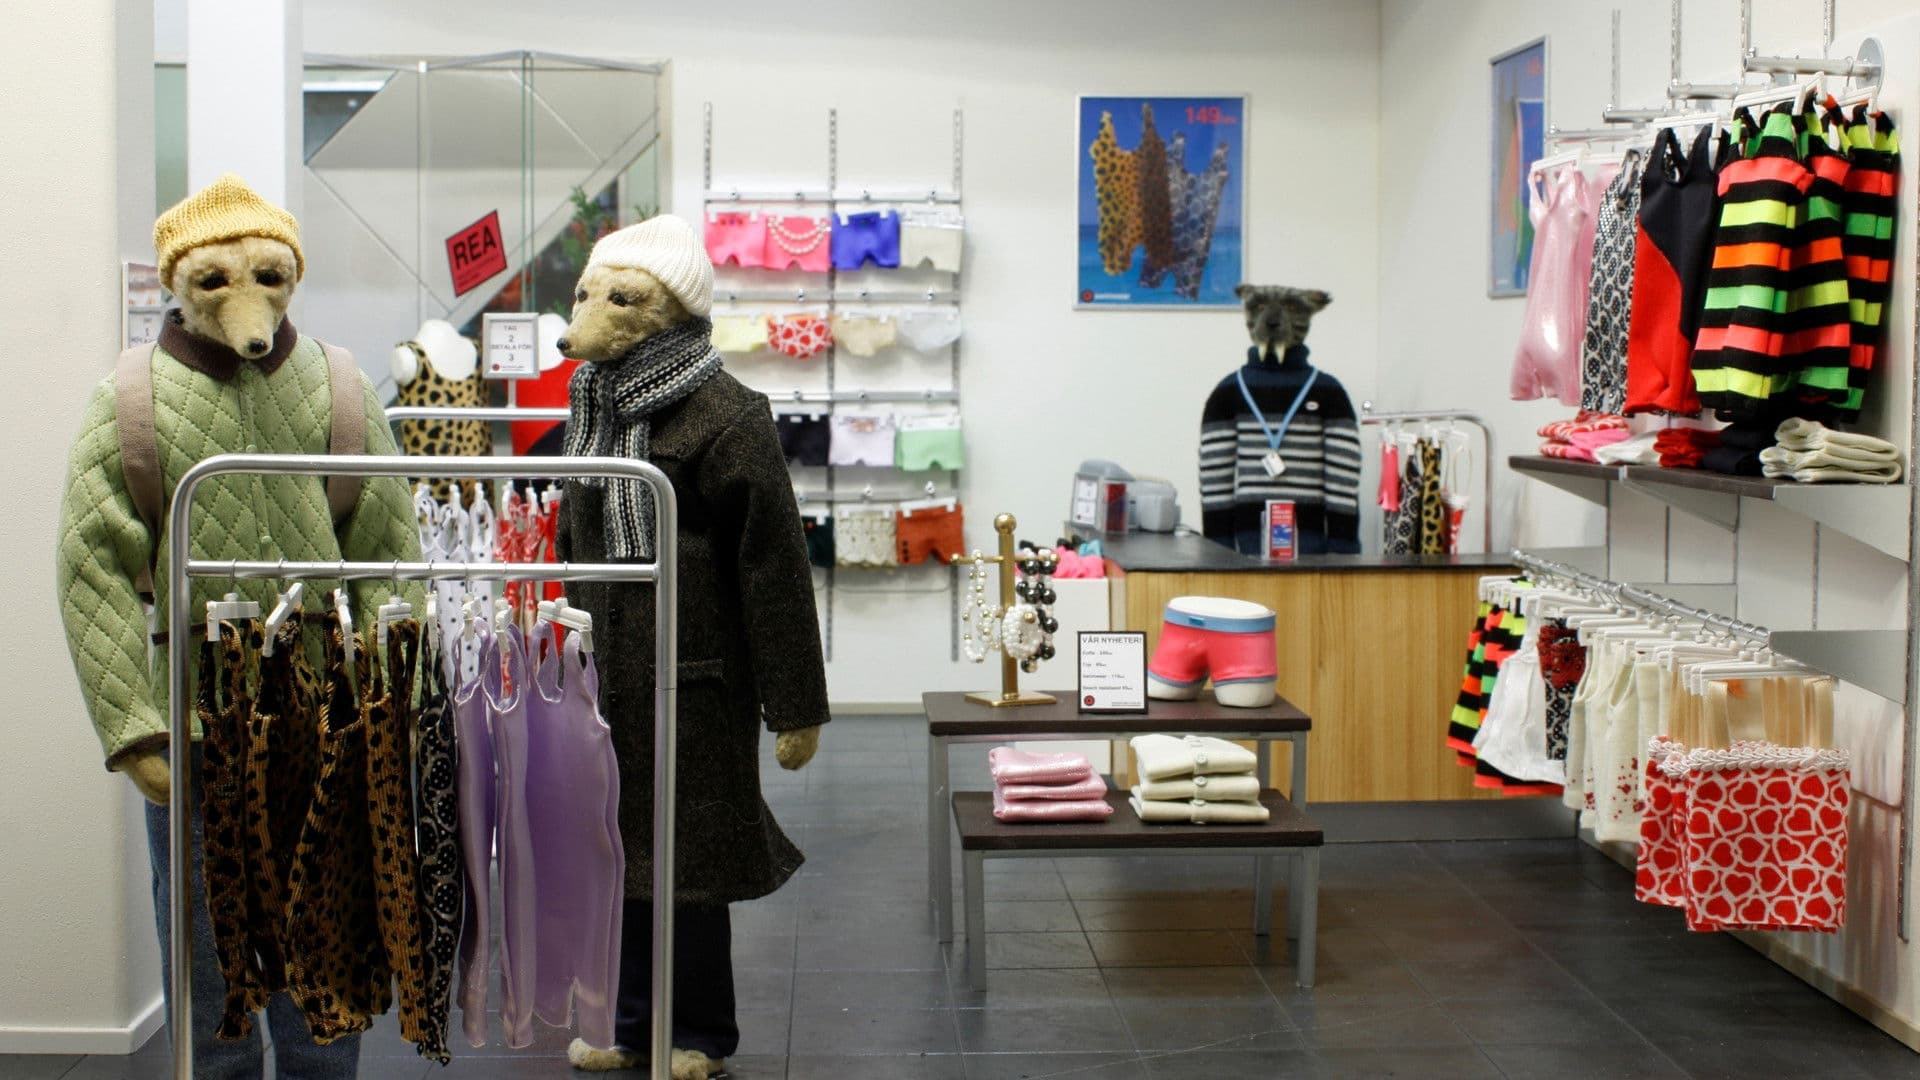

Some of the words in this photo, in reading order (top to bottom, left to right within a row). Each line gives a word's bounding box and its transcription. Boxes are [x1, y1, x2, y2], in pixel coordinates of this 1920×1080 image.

[453, 225, 497, 270] REA
[508, 334, 514, 342] 2
[508, 353, 514, 361] 3
[1082, 635, 1099, 643] VÅR
